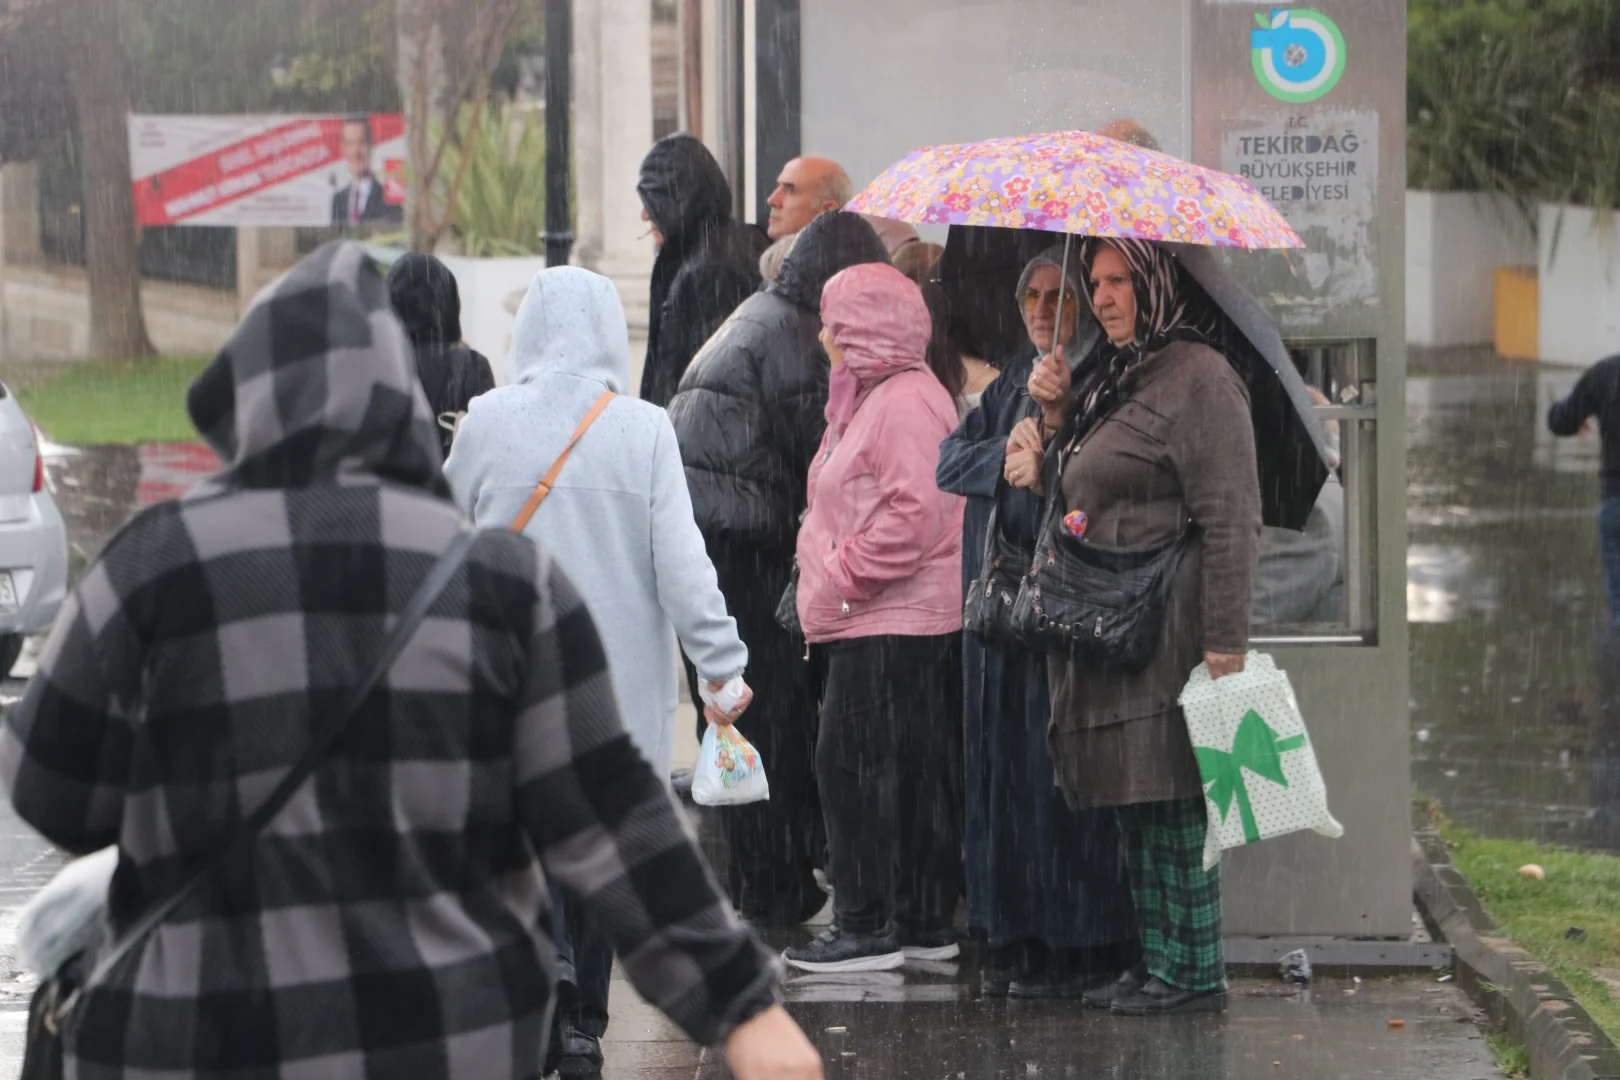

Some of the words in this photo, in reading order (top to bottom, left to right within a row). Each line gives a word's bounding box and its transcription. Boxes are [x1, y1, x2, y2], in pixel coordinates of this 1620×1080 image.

[1239, 129, 1359, 155] TEKİRDAĞ
[1240, 158, 1357, 181] BÜYÜKŞEHİR
[1257, 181, 1349, 201] ELEDİYESİ
